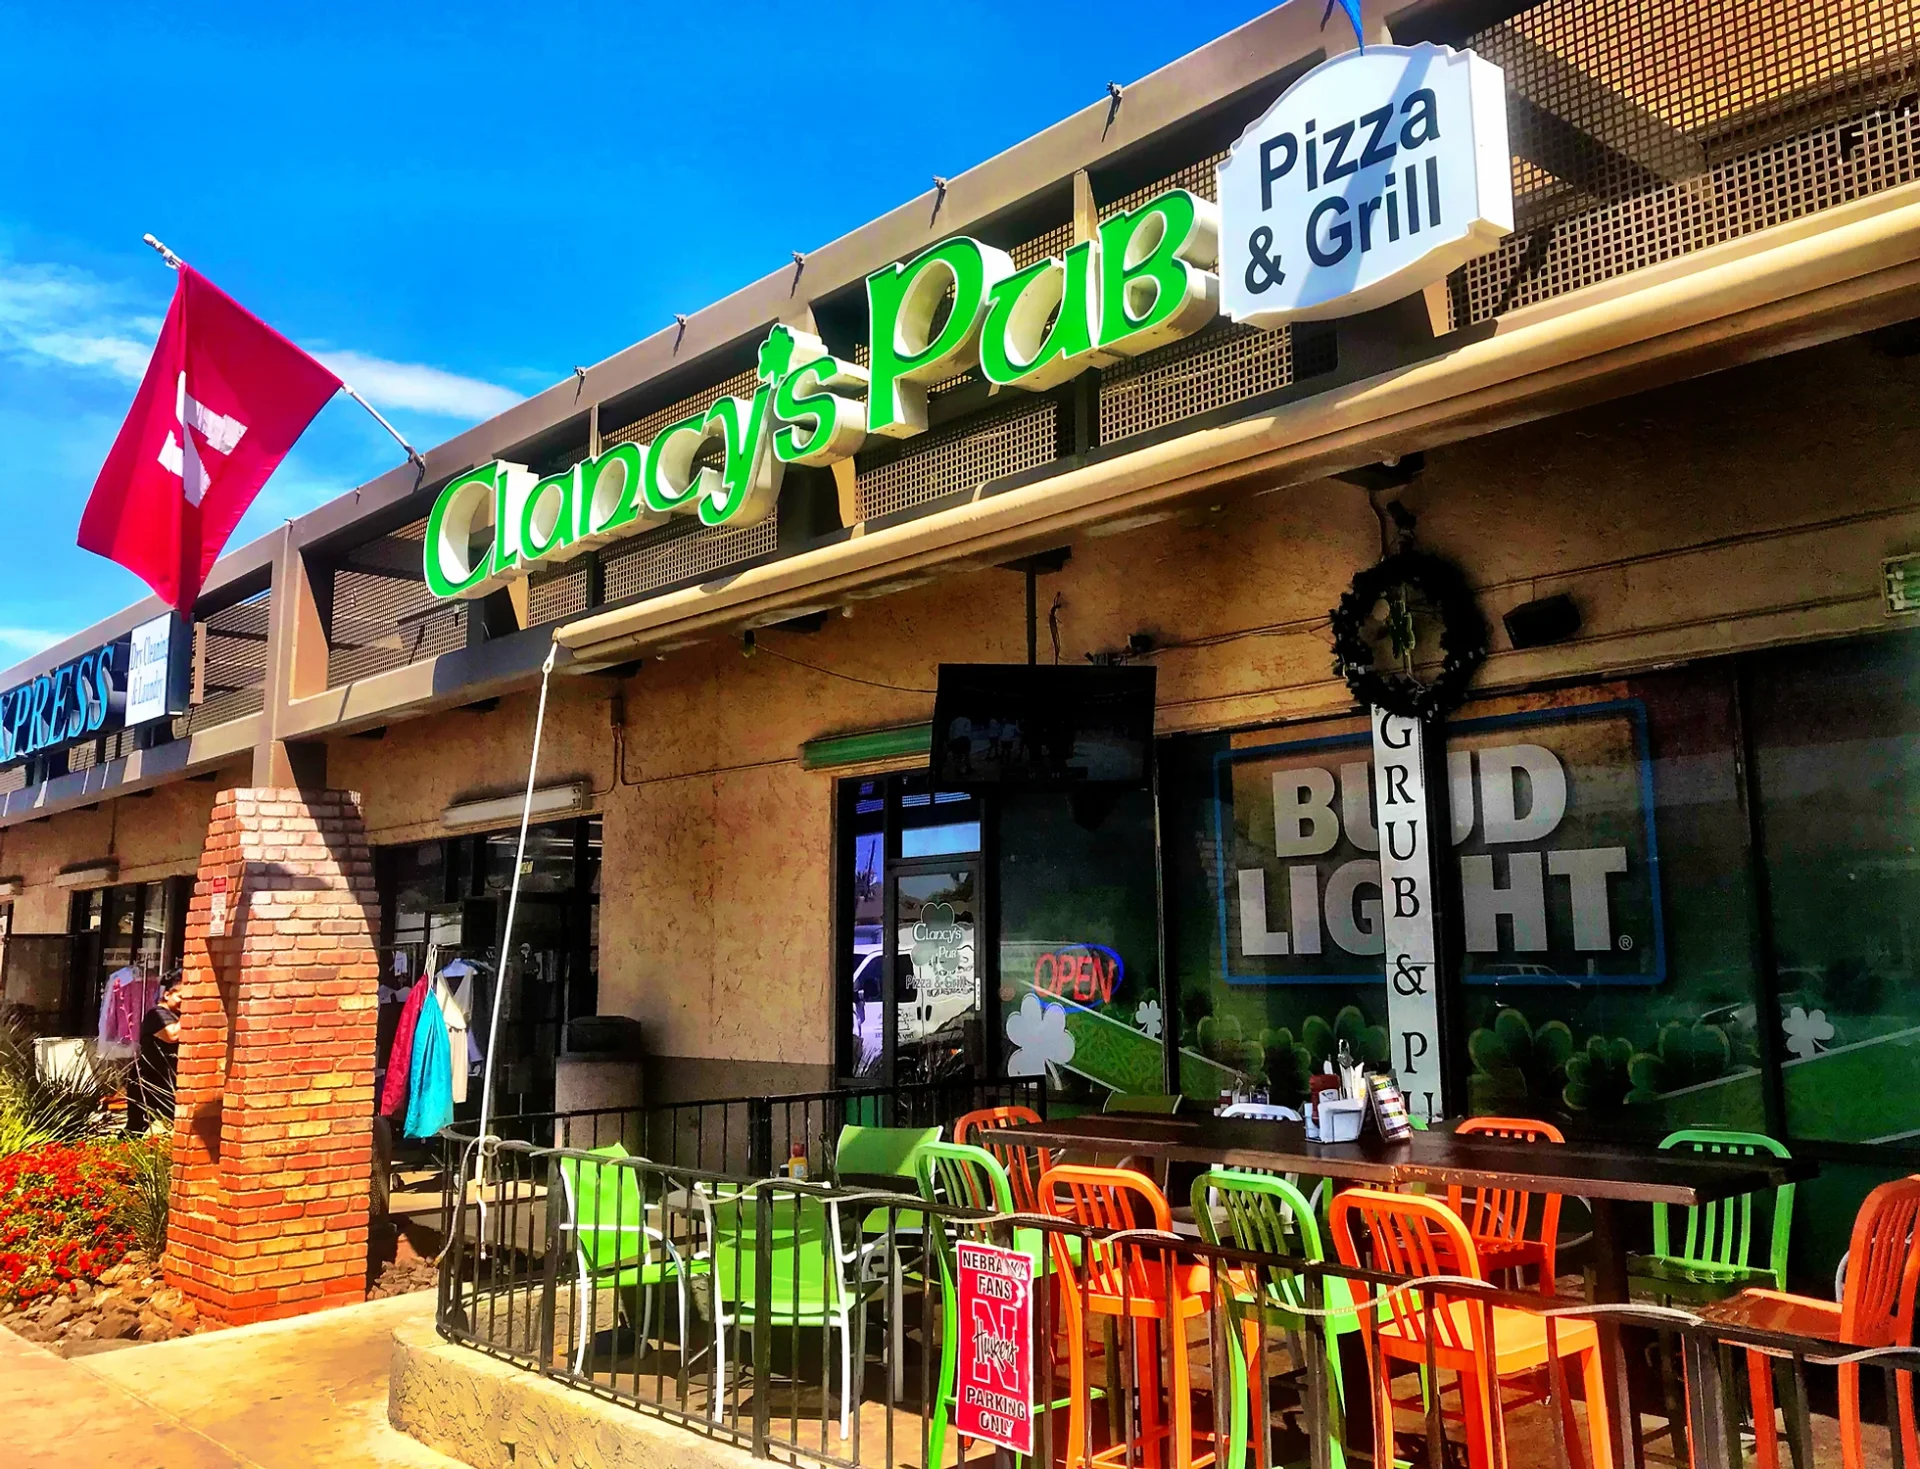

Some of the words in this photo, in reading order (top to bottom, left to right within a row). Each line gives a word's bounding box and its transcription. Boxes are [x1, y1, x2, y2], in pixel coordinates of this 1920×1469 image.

[1259, 88, 1441, 211] Pizza
[1244, 225, 1286, 294] &
[1306, 156, 1441, 267] Grill
[1272, 744, 1567, 858] BUD
[1380, 711, 1420, 918] GRUB
[1238, 847, 1628, 956] LIGHT
[913, 923, 962, 943] Clancy's
[906, 975, 931, 989] Pizza
[1034, 951, 1116, 1004] OPEN
[1393, 953, 1427, 995] &
[962, 1251, 1026, 1279] NEBRAKA
[978, 1275, 1011, 1299] FANS
[973, 1316, 1018, 1371] Huskers
[966, 1387, 1025, 1419] PARKING
[980, 1412, 1013, 1437] ONLY
